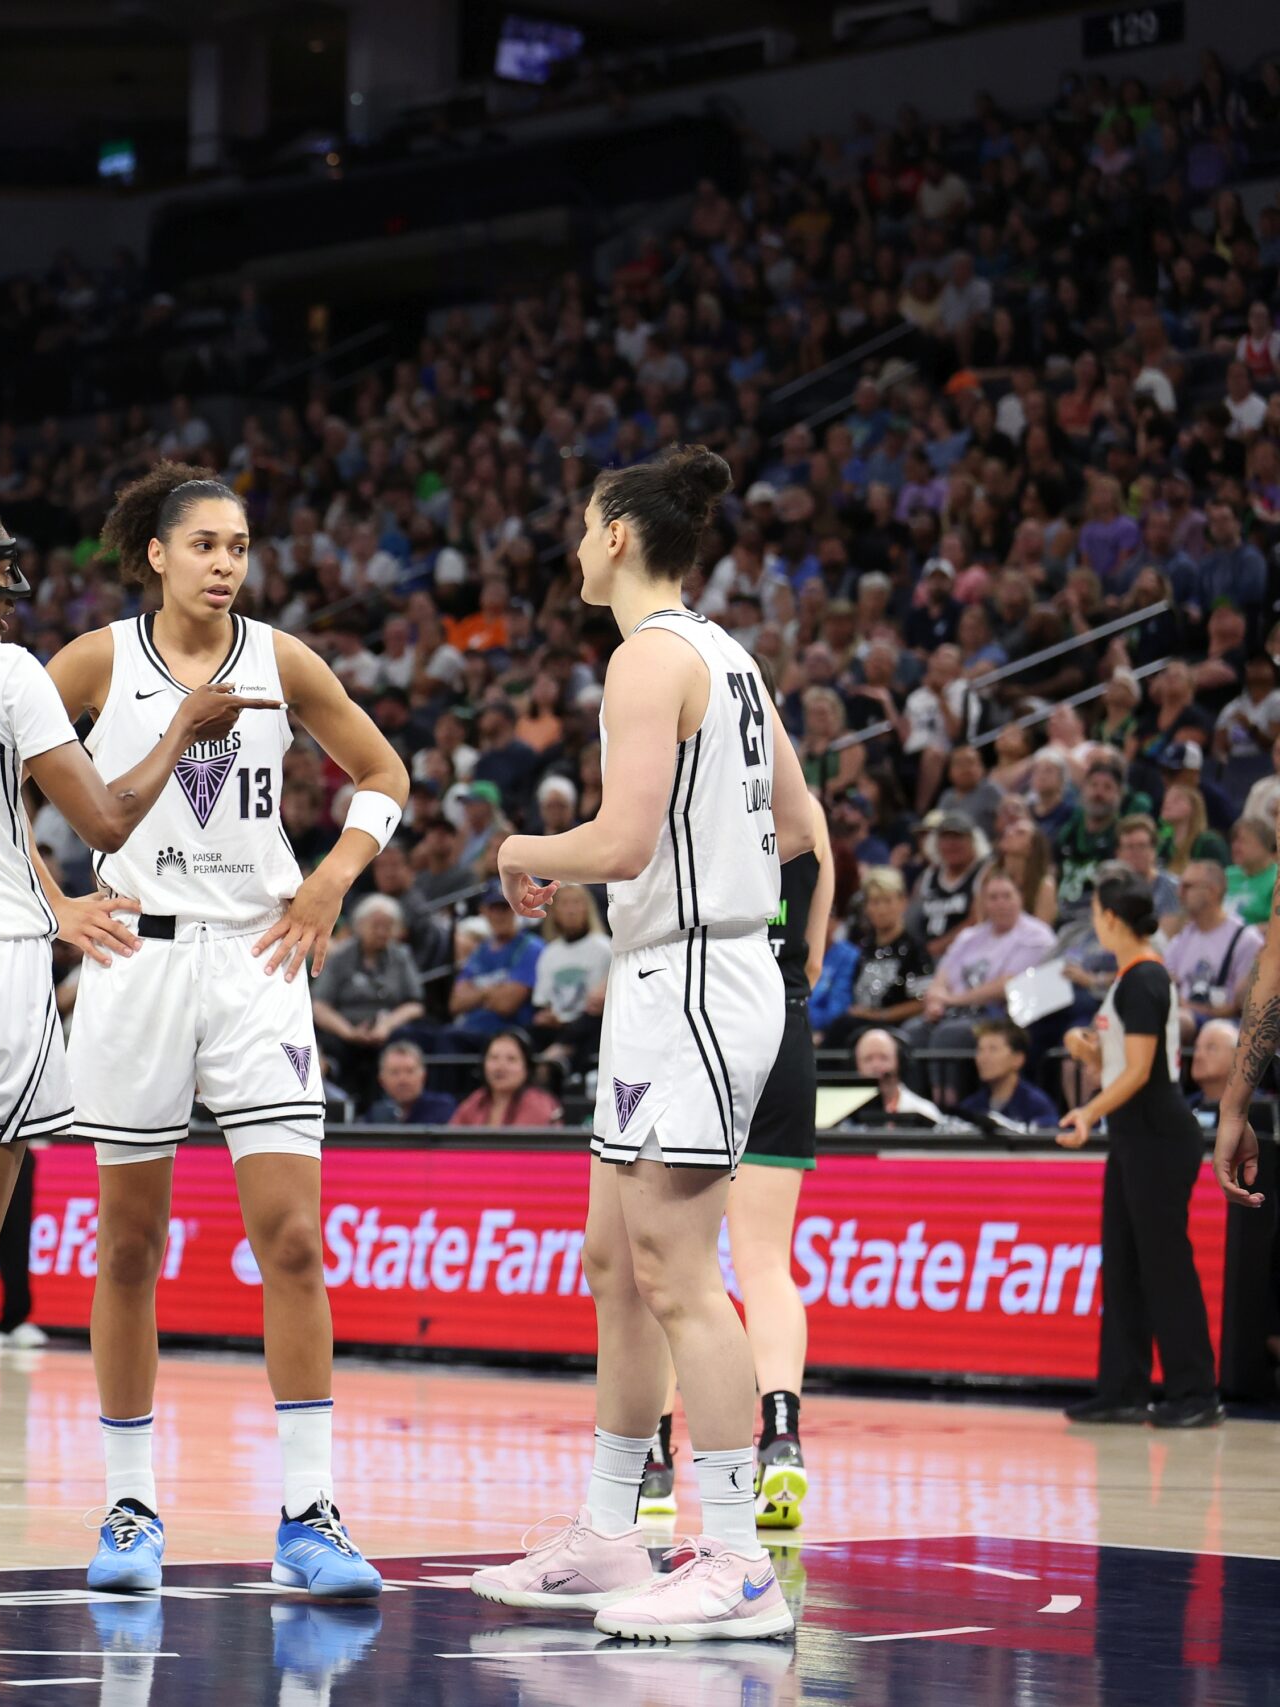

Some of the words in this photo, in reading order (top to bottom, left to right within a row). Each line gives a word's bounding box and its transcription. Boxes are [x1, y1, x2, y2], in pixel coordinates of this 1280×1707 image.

[239, 683, 267, 694] freedom
[236, 767, 273, 819] 13
[192, 852, 223, 863] KAISER
[193, 863, 256, 875] PERMANENTE
